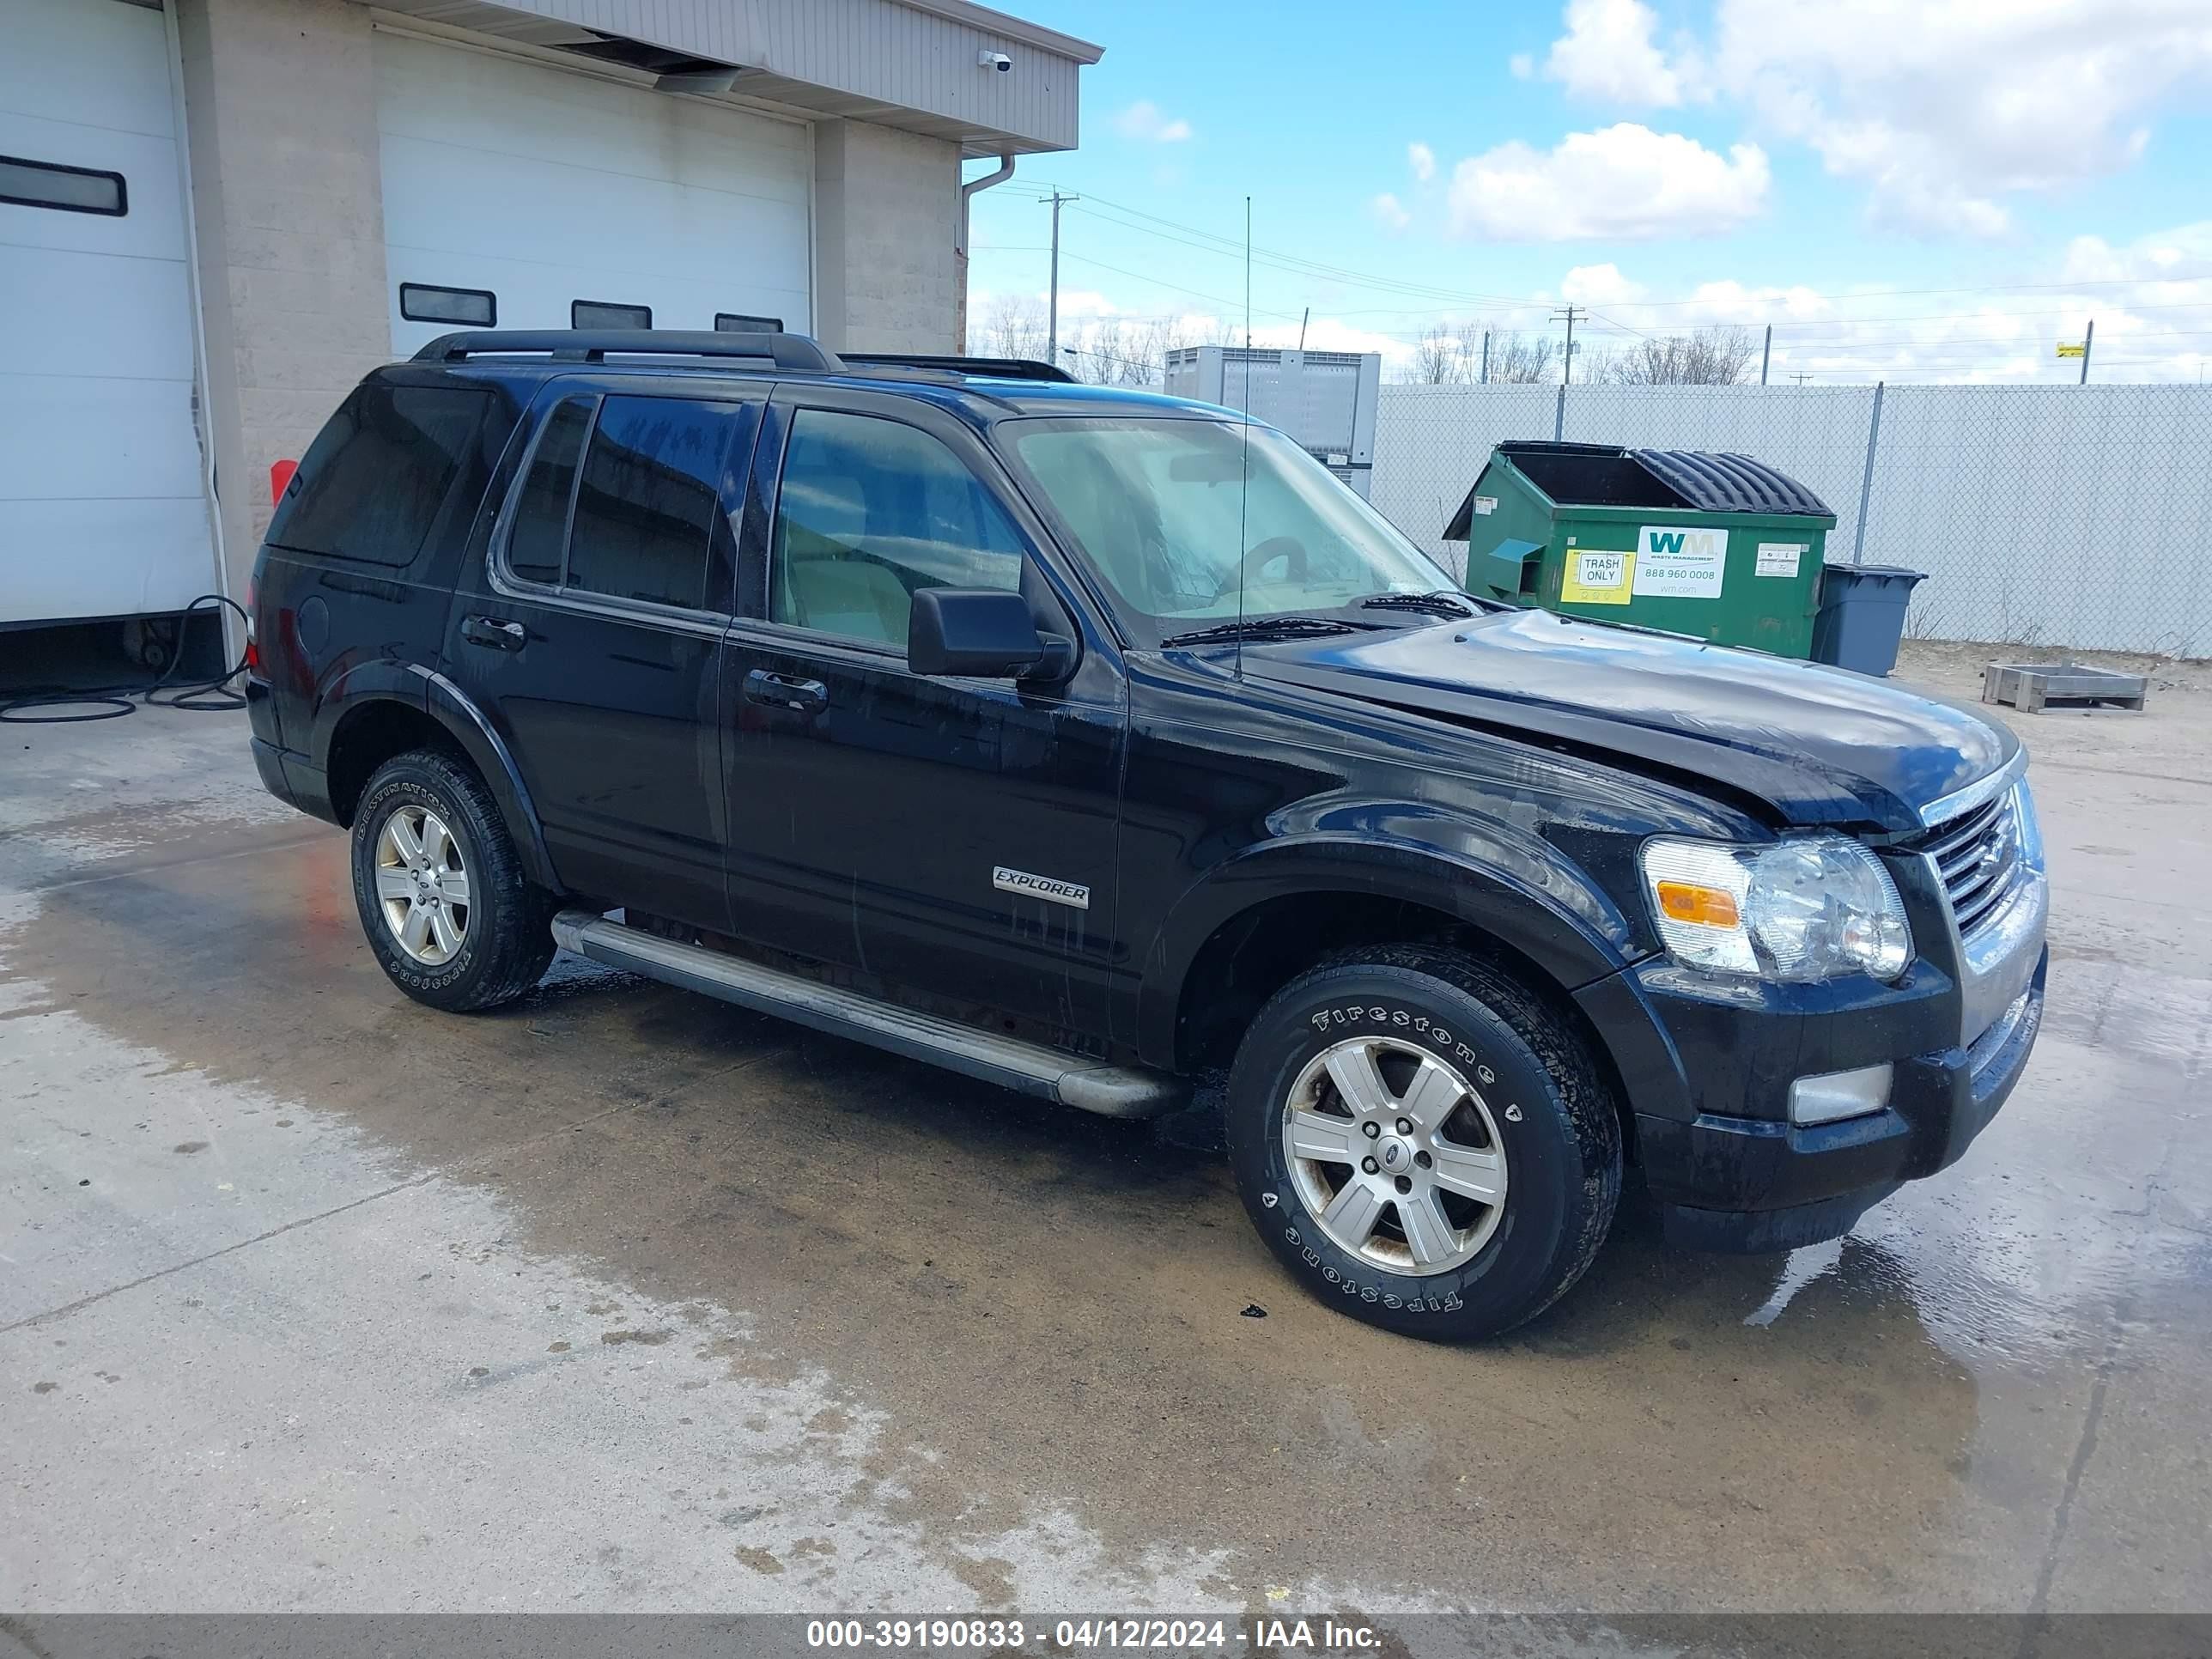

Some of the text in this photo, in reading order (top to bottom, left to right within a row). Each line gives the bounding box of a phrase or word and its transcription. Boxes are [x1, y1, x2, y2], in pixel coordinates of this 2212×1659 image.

[1650, 532, 1715, 555] WM
[1585, 559, 1620, 569] TRASH
[1587, 570, 1616, 580] ONLY
[1645, 568, 1715, 580] 888 960 0008
[1661, 585, 1697, 594] wm.com
[357, 782, 451, 842] DESTINATION
[995, 870, 1086, 900] EXPLORER
[391, 949, 472, 990] Firestone
[1311, 1006, 1496, 1085] Firestone
[1285, 1226, 1463, 1313] Firestone
